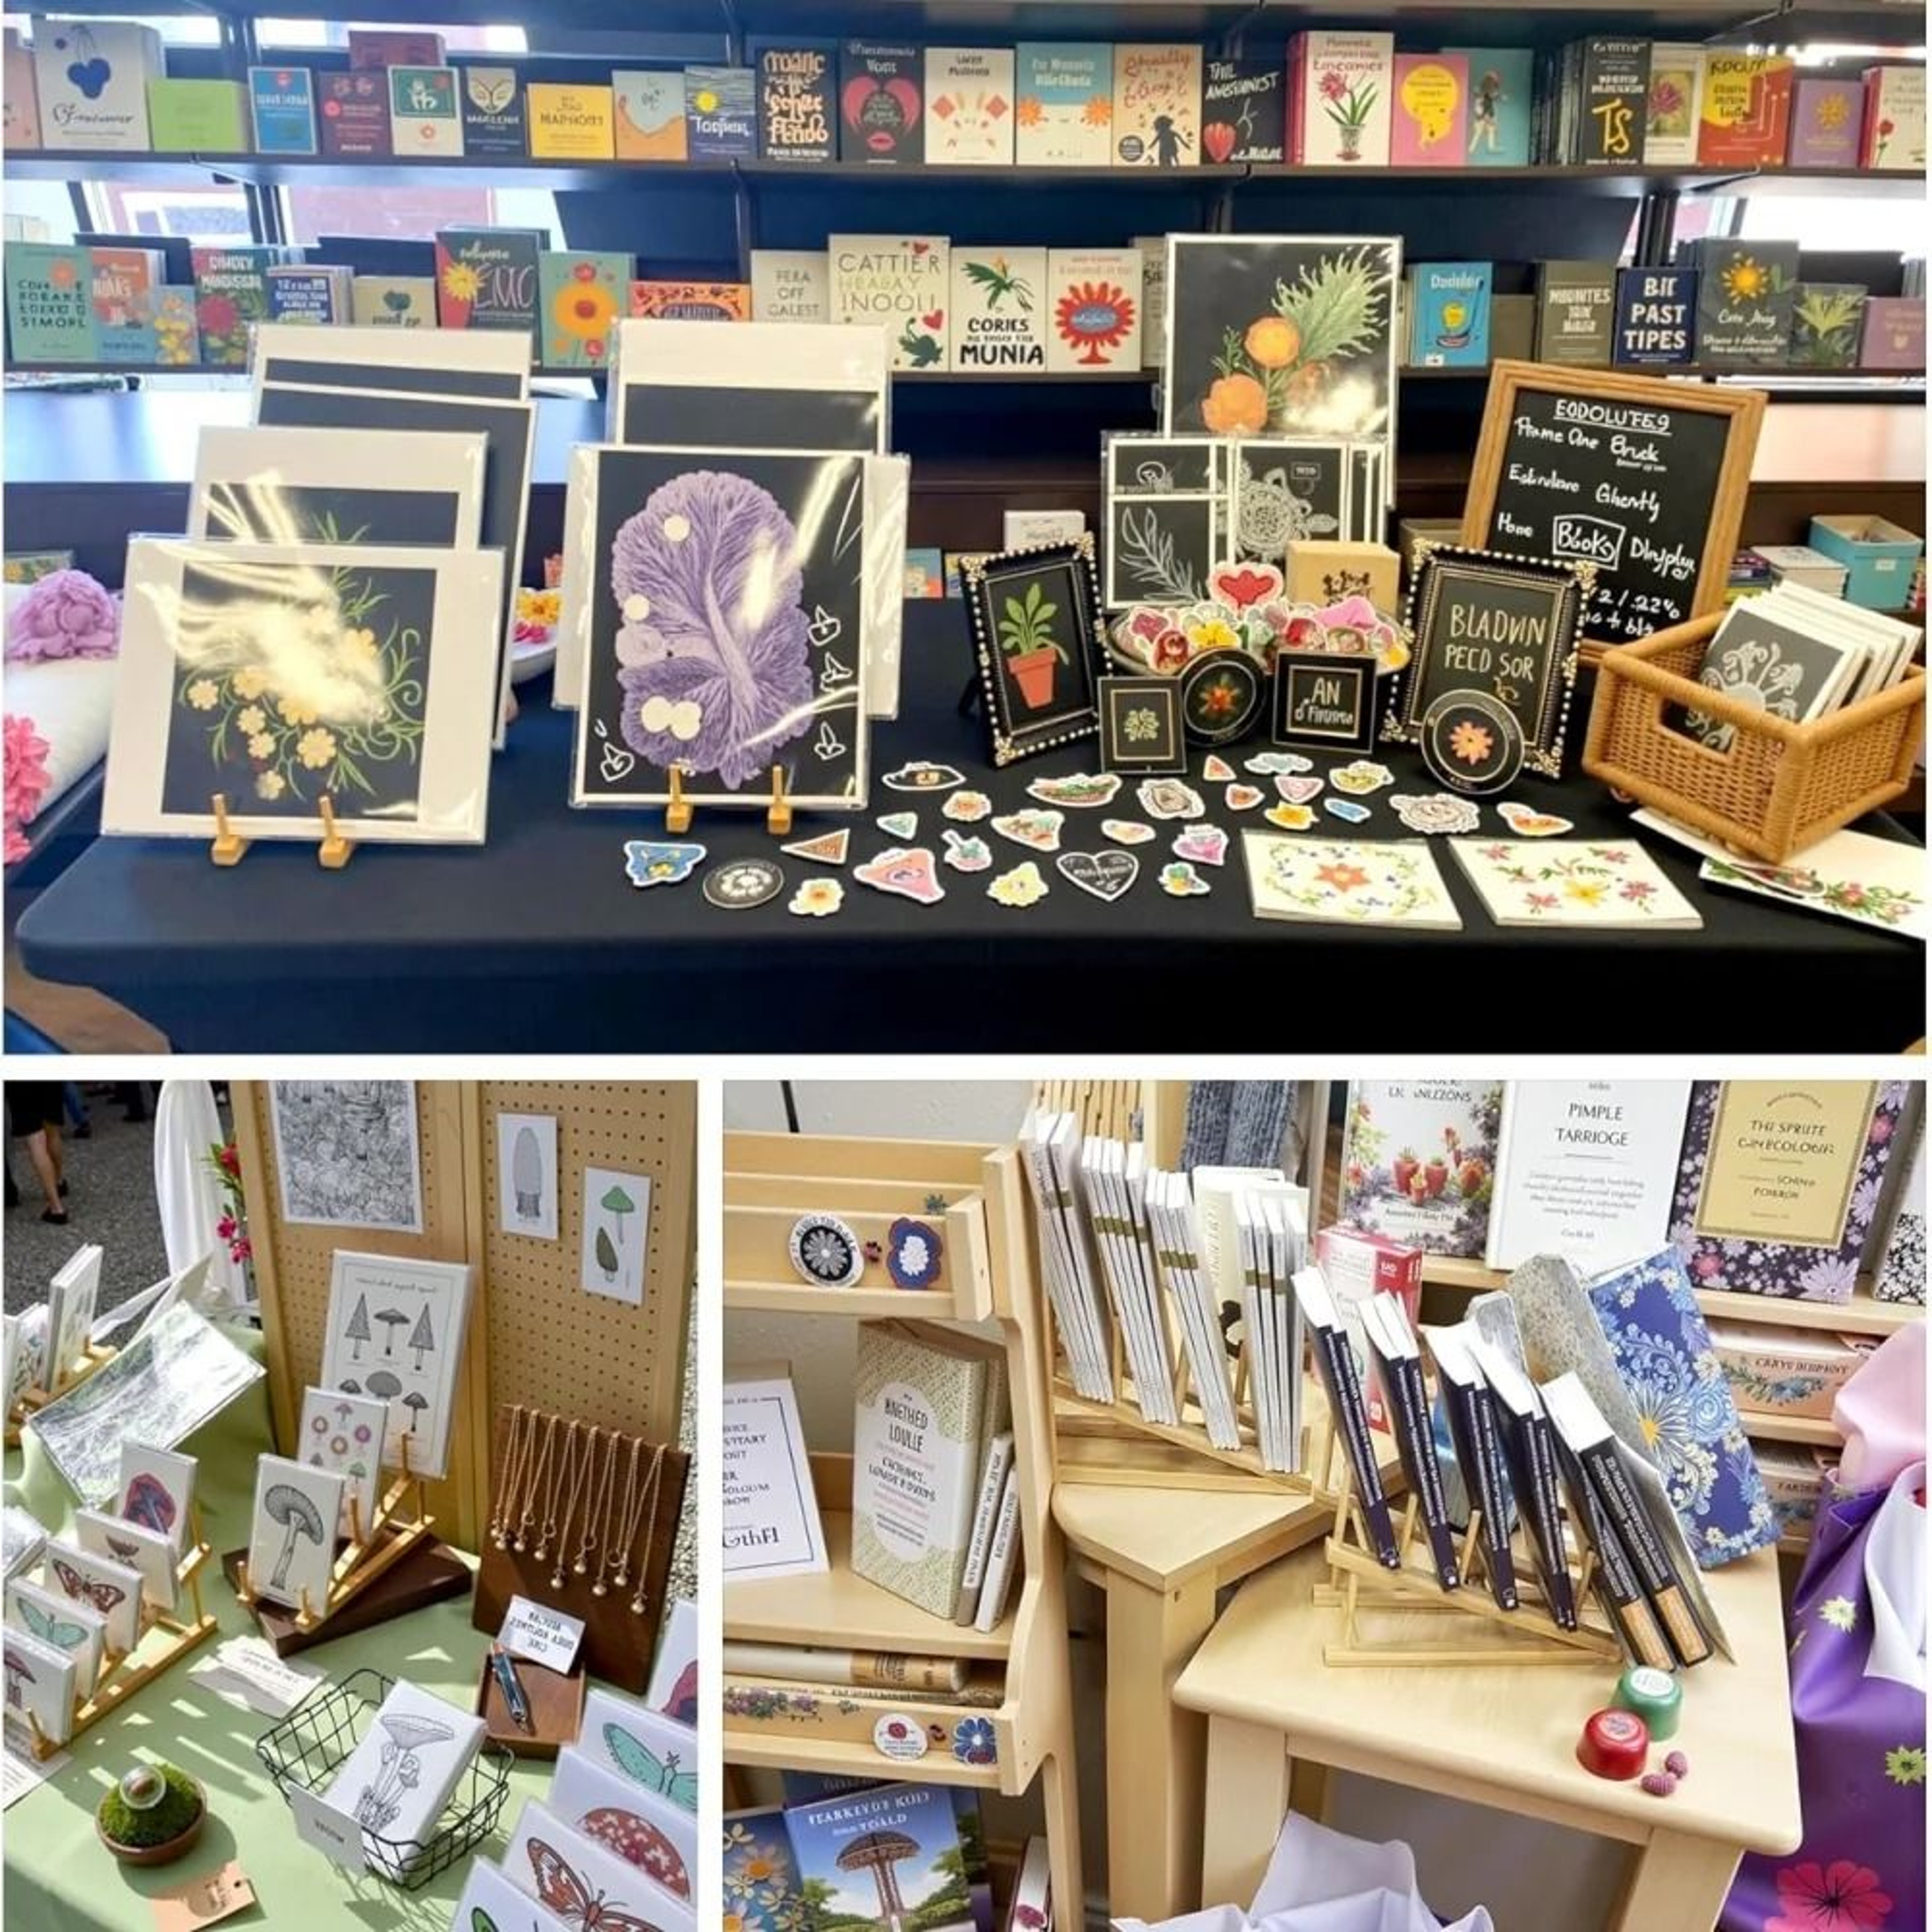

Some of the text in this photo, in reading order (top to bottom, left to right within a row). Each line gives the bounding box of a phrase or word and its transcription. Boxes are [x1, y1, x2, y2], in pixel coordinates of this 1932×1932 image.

[1631, 303, 1687, 324] PAST
[1624, 330, 1686, 351] TIPES
[959, 344, 1044, 365] MUNIA
